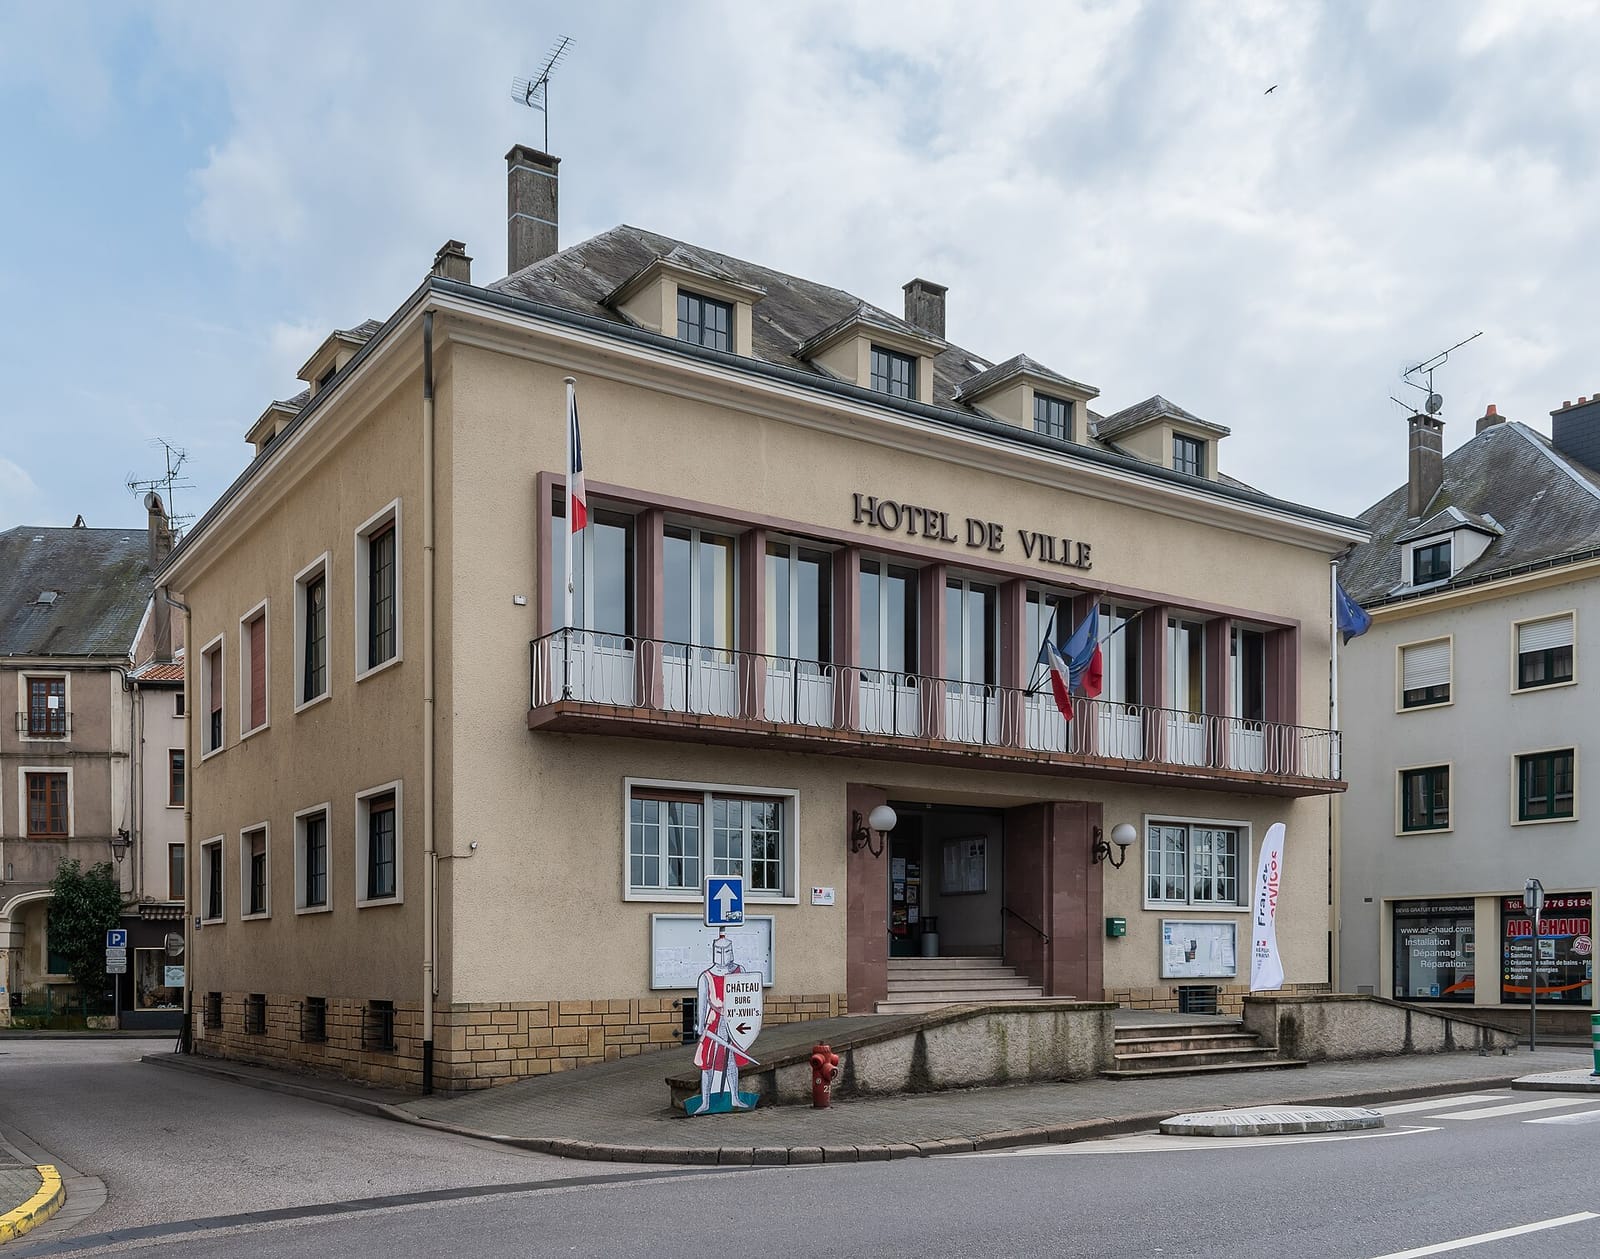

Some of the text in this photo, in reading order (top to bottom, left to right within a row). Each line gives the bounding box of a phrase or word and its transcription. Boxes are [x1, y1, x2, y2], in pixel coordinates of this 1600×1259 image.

[853, 492, 1092, 569] HOTEL DE VILLE
[1507, 901, 1522, 909] Tél.
[1552, 900, 1564, 908] 76
[1567, 899, 1578, 907] 51
[1400, 925, 1472, 935] www.air-chaud.com
[1507, 918, 1590, 937] AIR CHAUD
[112, 933, 121, 945] P
[1405, 938, 1451, 946] Installation
[1413, 949, 1461, 959] Dépannage
[1420, 959, 1467, 969] Réparation
[726, 981, 759, 993] CHÂTEAU
[734, 996, 751, 1005] BURG
